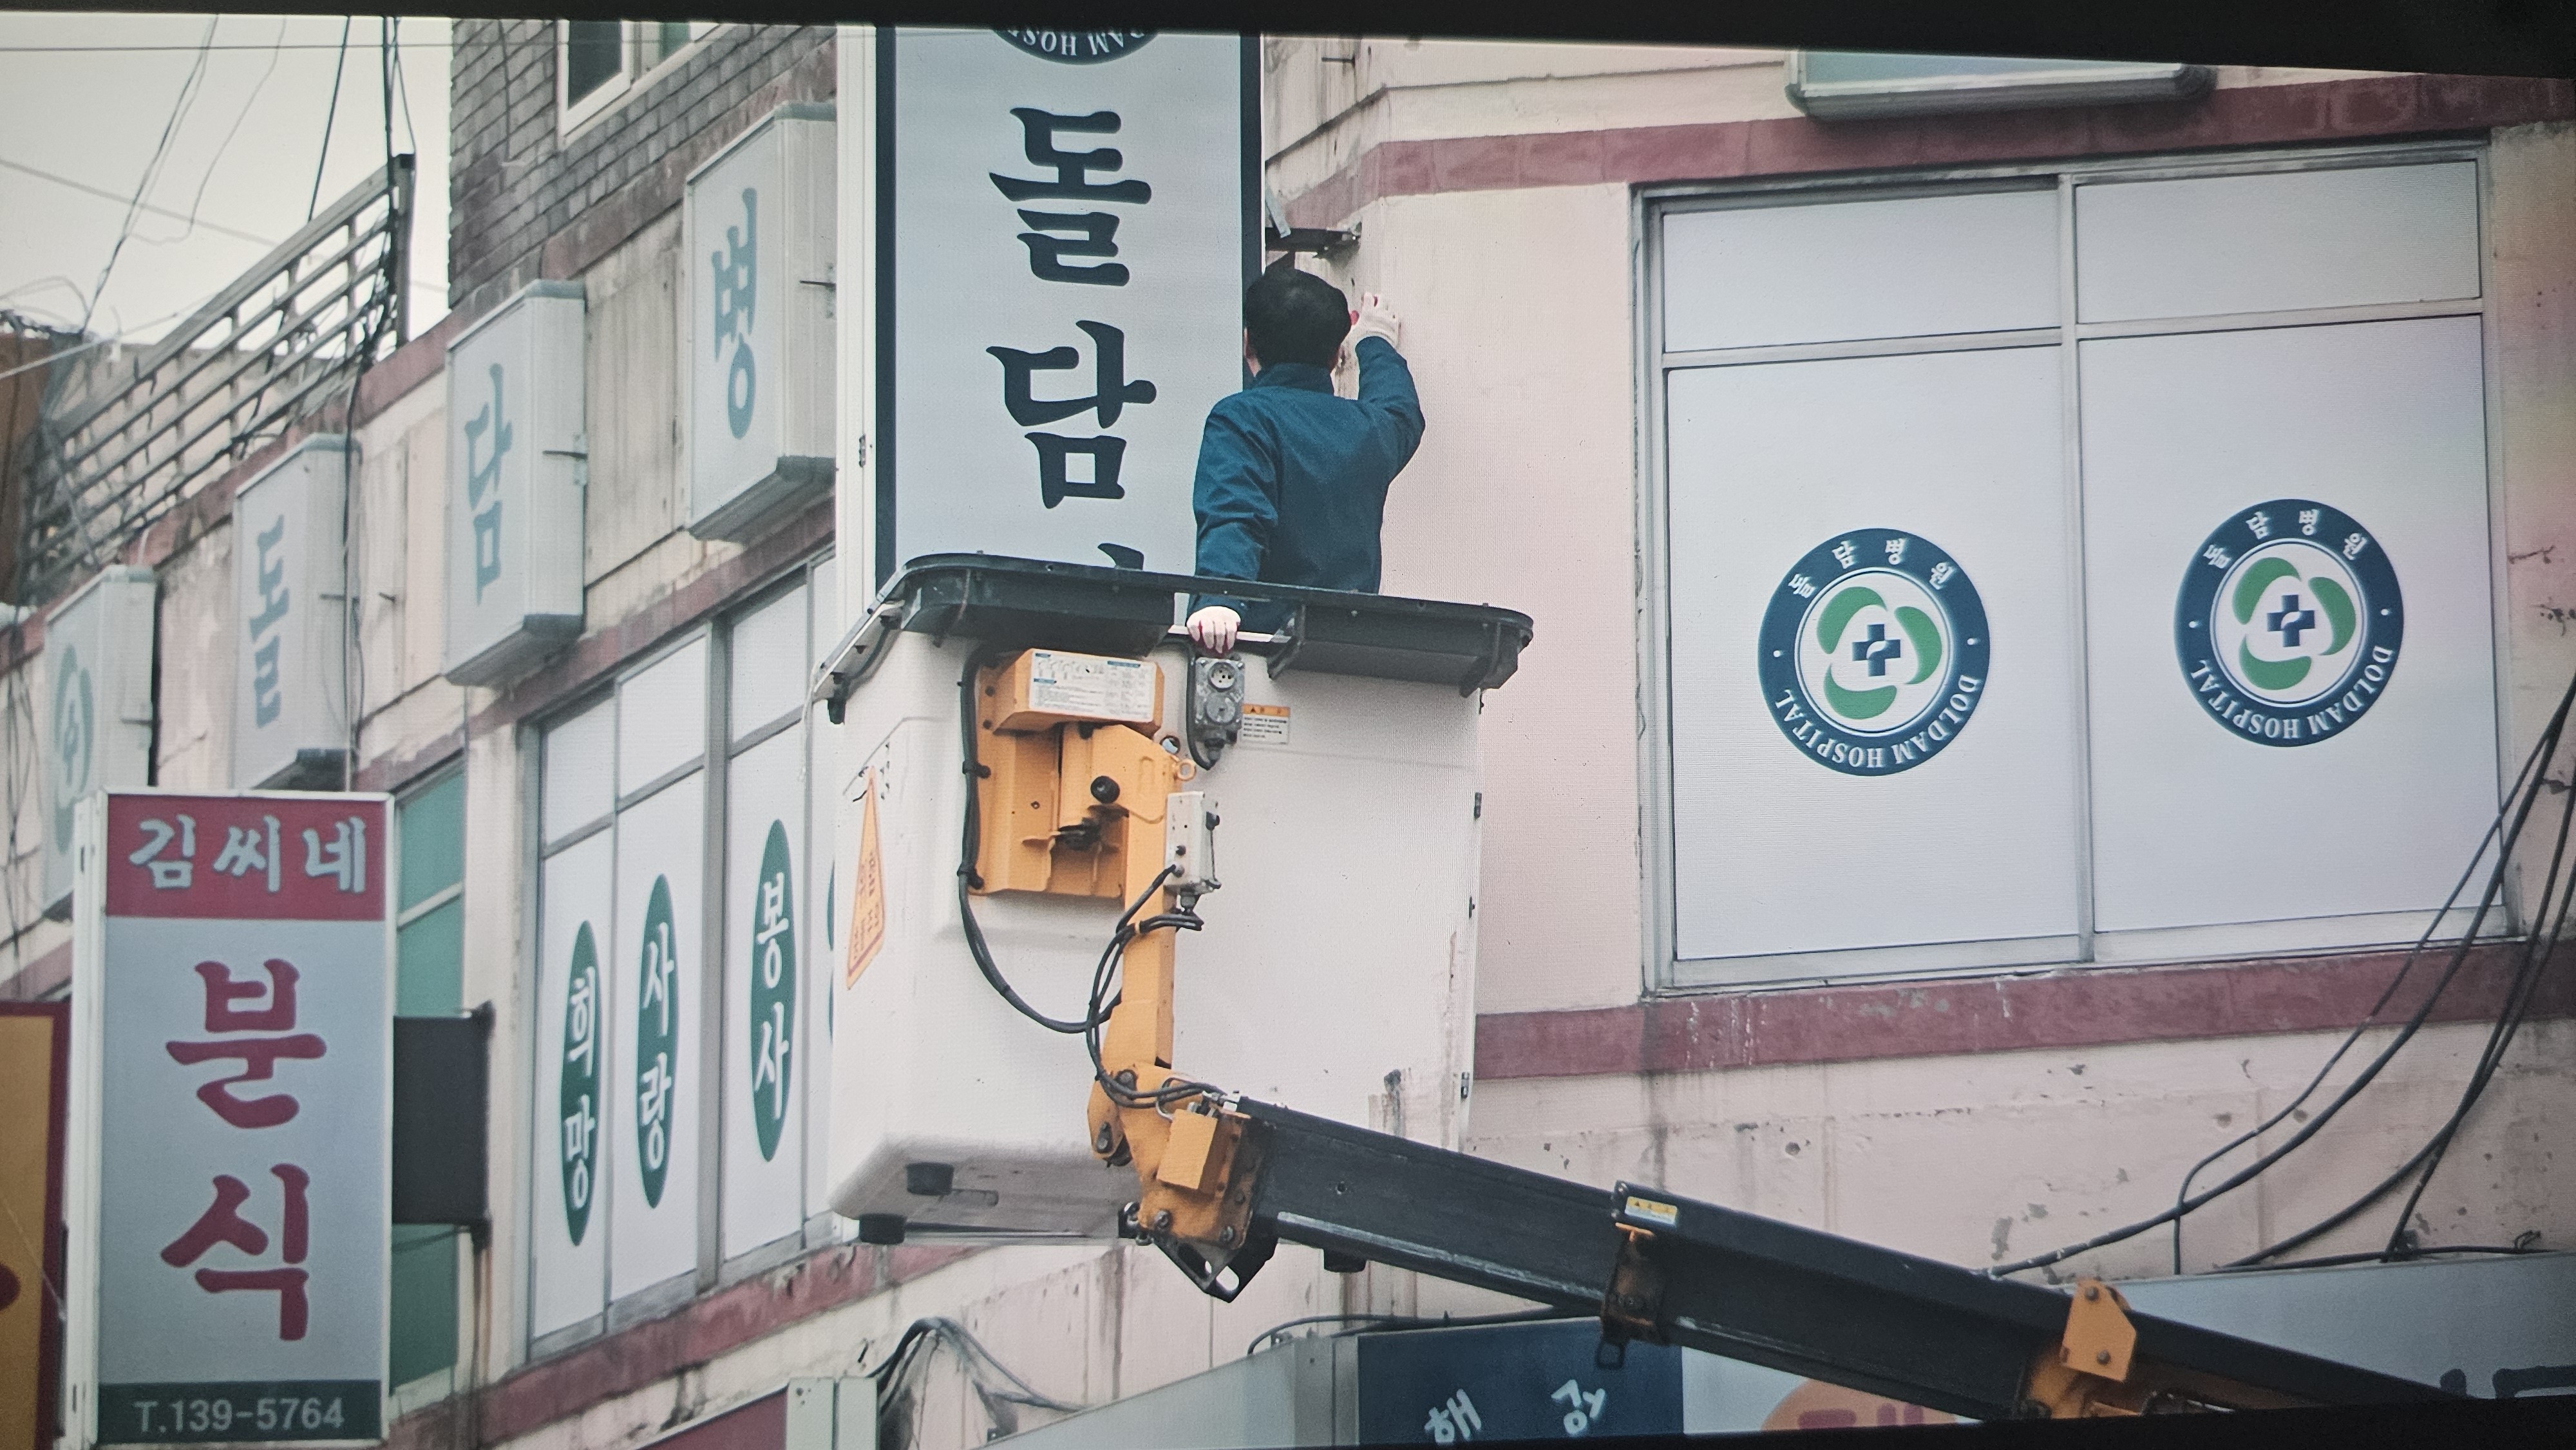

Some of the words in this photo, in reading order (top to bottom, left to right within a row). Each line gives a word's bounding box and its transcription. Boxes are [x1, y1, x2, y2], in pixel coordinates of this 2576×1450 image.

[712, 187, 757, 439] 병
[986, 107, 1157, 570] 돌담
[464, 362, 512, 606] 담
[2203, 509, 2367, 569] 돌담병원
[249, 514, 290, 728] 돌
[1788, 538, 1955, 598] 돌담병원
[1774, 688, 1882, 768] HOSPITAL
[1891, 674, 1980, 764] DOLDAM
[2191, 658, 2298, 739] HOSPITAL
[2306, 645, 2393, 735] DOLDAM
[129, 813, 367, 894] 김씨네
[638, 921, 674, 1170] 사랑
[753, 872, 789, 1120] 봉사
[160, 958, 328, 1342] 분식
[563, 966, 596, 1209] 희망
[133, 1397, 346, 1434] T.139-5764
